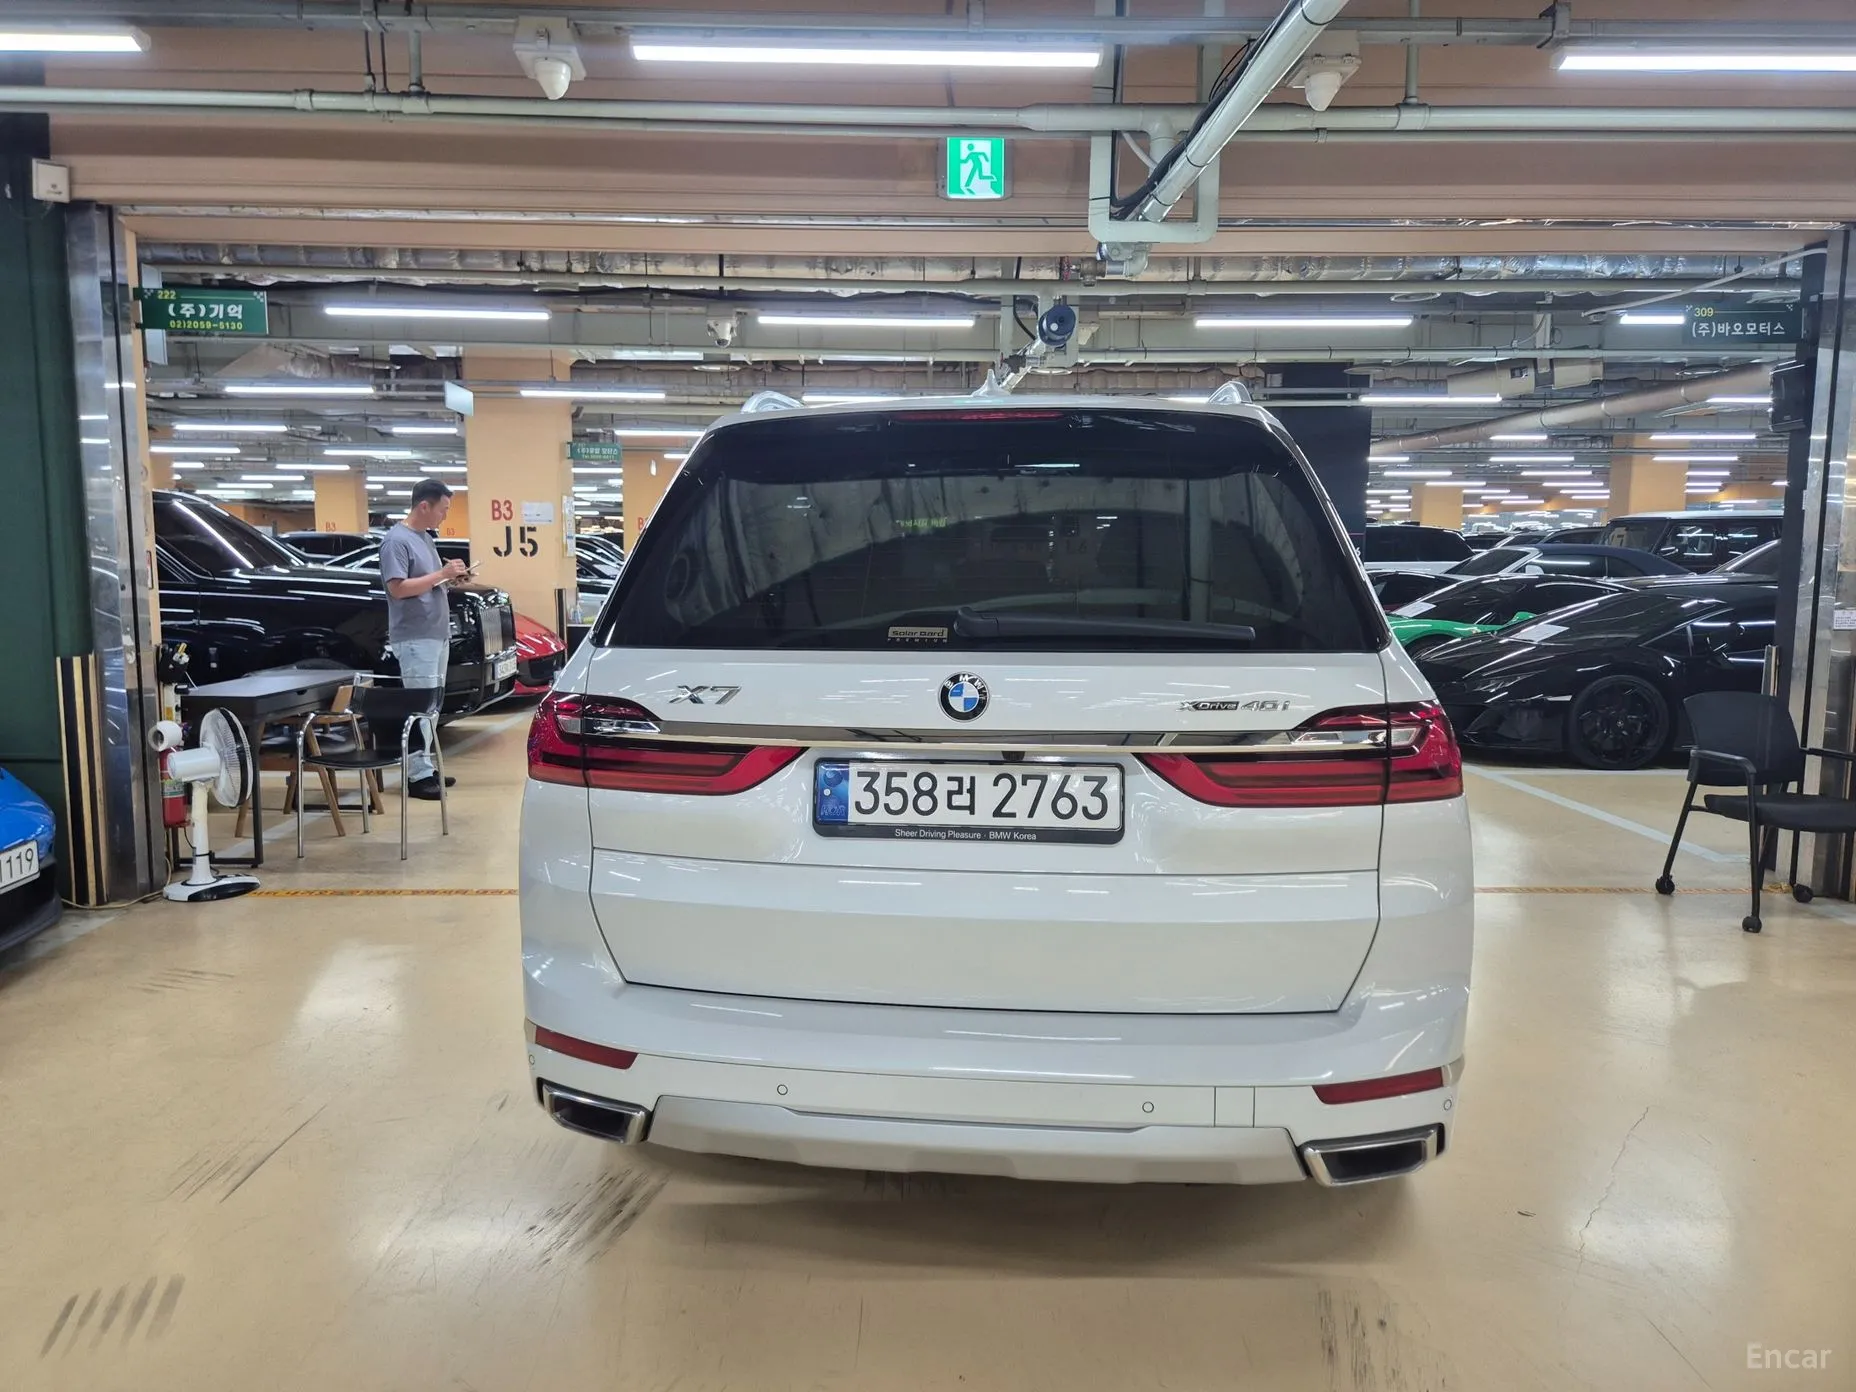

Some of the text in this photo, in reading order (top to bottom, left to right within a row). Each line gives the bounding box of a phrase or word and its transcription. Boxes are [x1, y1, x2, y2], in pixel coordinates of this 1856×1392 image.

[157, 290, 176, 299] 222
[168, 303, 243, 319] (주)기억
[1694, 307, 1714, 317] 309
[1692, 322, 1785, 337] (주)바오모터스
[491, 499, 513, 521] B3
[493, 526, 538, 557] J5
[944, 674, 985, 690] BMW
[668, 685, 742, 705] X7
[855, 771, 1109, 821] 358러 2763
[895, 829, 1037, 840] Sheer Driving Pleasure BMW Korea
